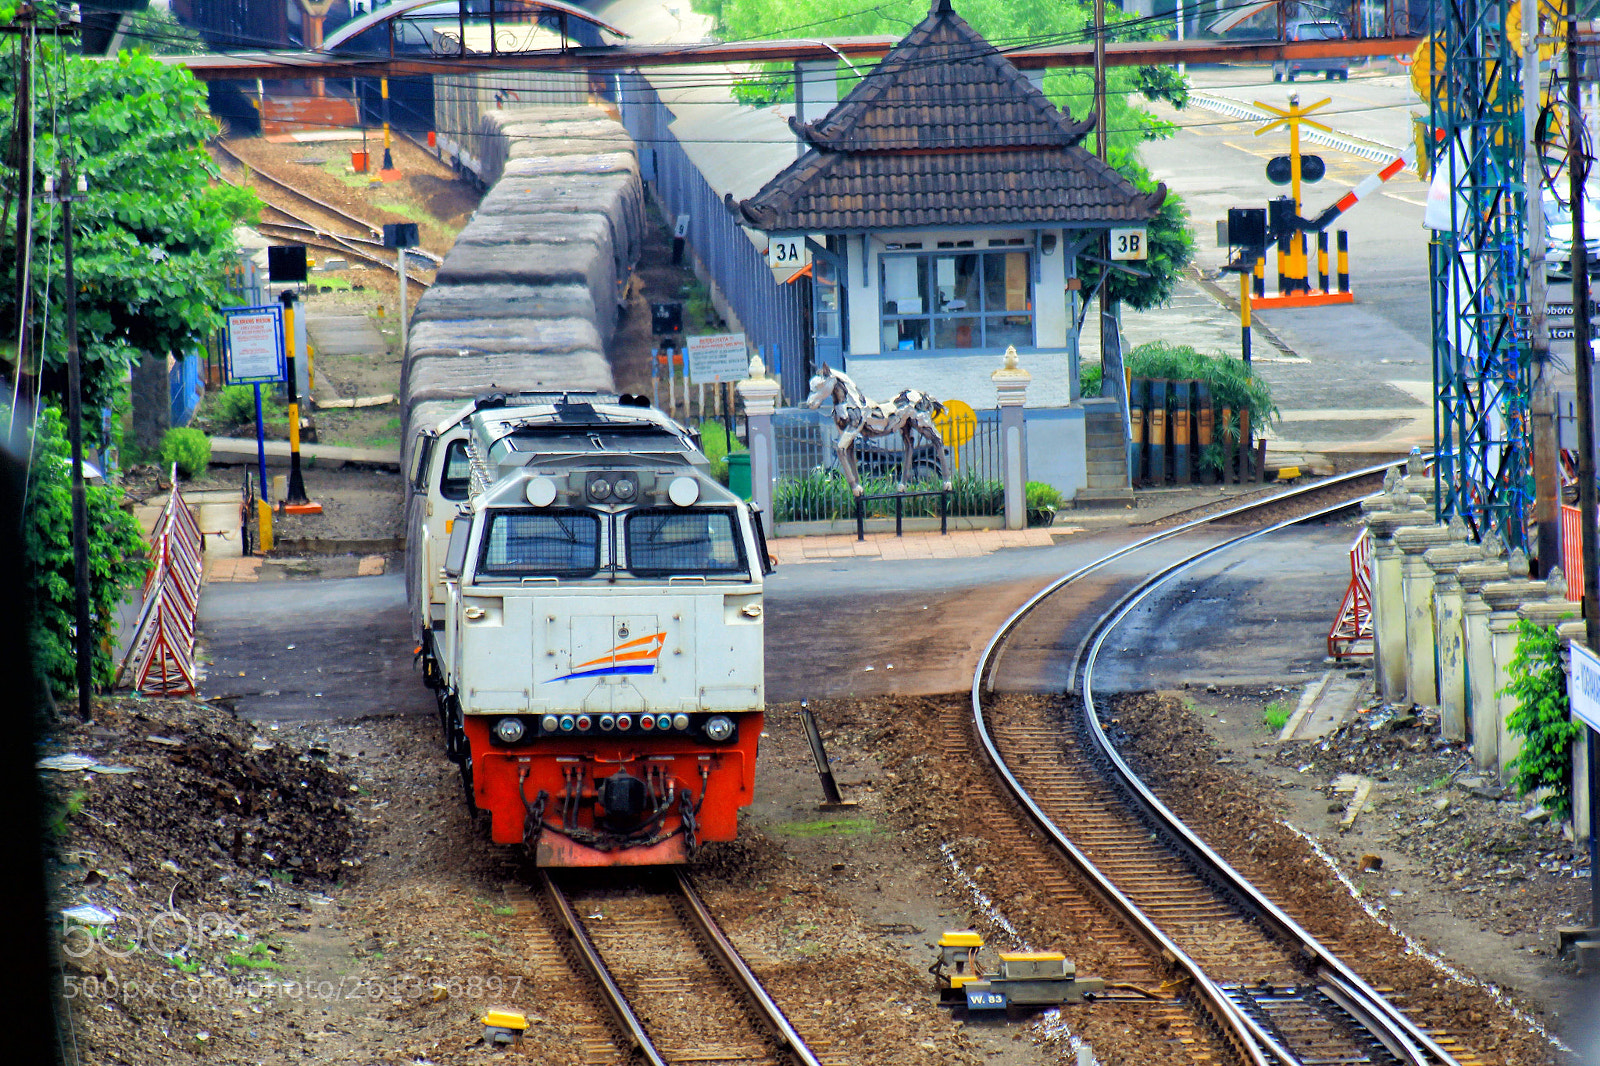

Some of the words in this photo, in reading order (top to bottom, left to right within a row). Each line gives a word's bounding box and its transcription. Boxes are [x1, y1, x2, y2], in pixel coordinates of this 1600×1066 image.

[776, 243, 798, 261] 3A
[1118, 235, 1140, 253] 3B
[970, 995, 985, 1004] W.
[988, 995, 1002, 1004] 83
